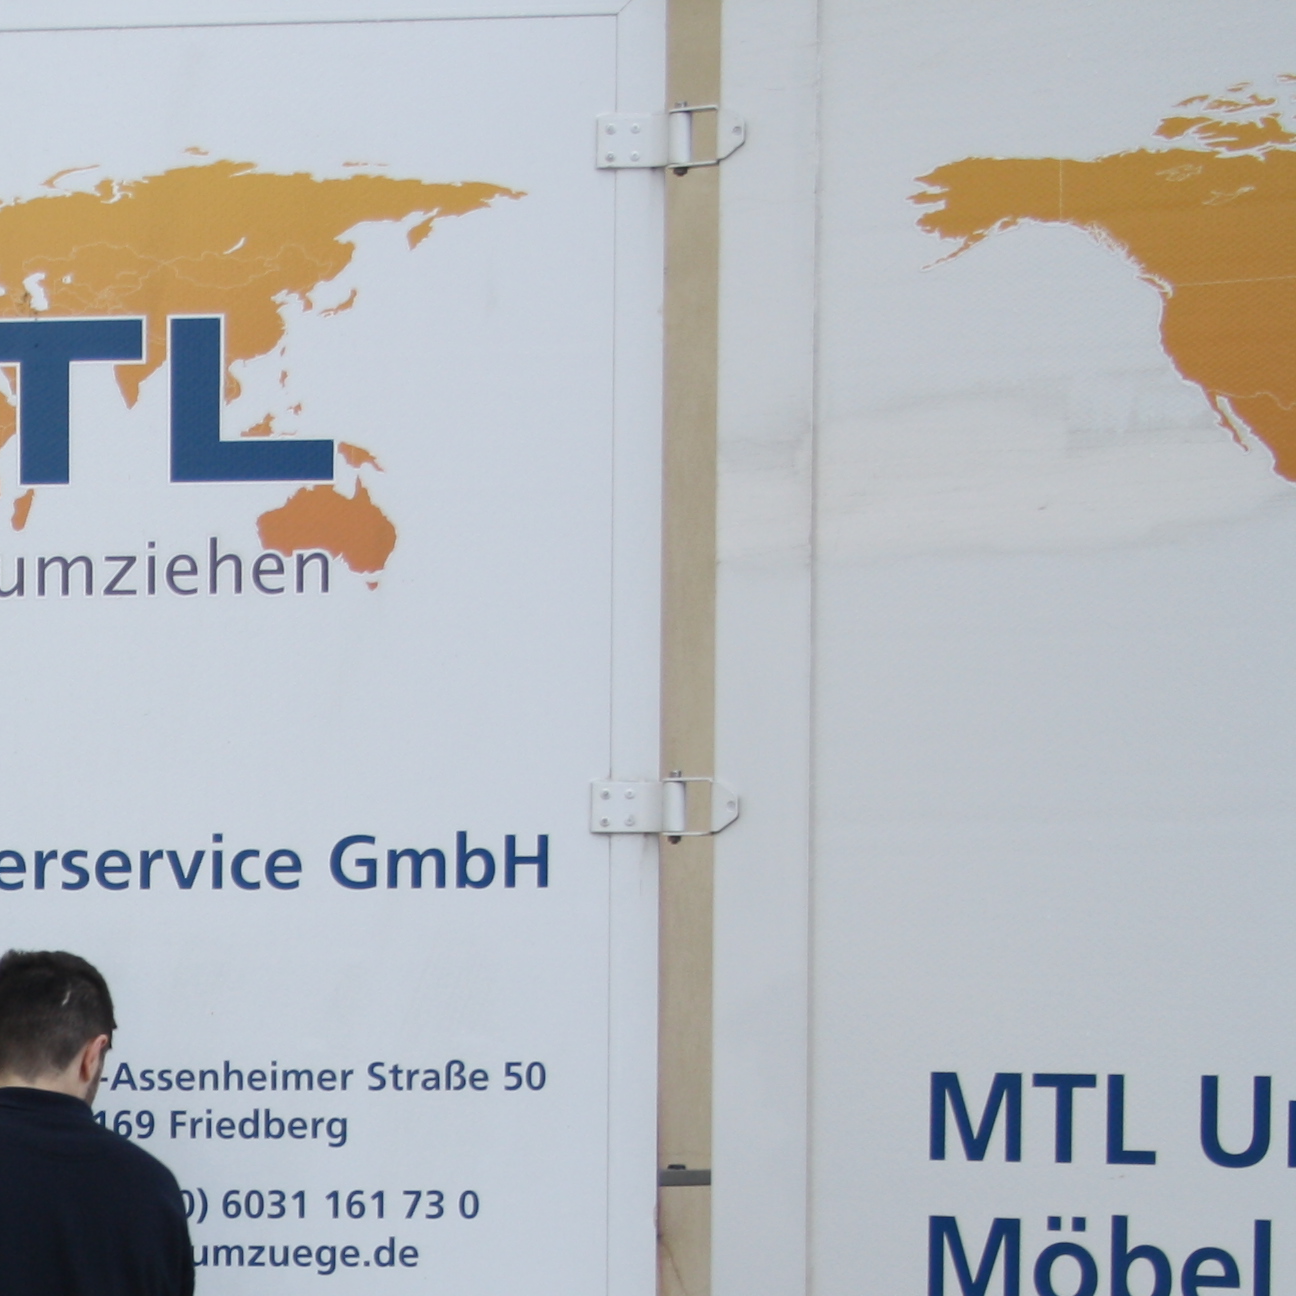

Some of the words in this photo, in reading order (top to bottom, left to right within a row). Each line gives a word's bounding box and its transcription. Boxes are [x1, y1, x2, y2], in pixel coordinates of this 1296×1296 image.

[329, 830, 551, 891] GmbH
[367, 1060, 490, 1091] Straße
[503, 1061, 547, 1091] 50
[170, 1108, 348, 1148] Friedberg
[929, 1071, 1157, 1165] MTL
[1200, 1075, 1296, 1169] U
[221, 1189, 307, 1219] 6031
[325, 1189, 387, 1219] 161
[402, 1189, 444, 1219] 73
[458, 1189, 481, 1219] 0
[192, 1236, 420, 1276] umzuege.de
